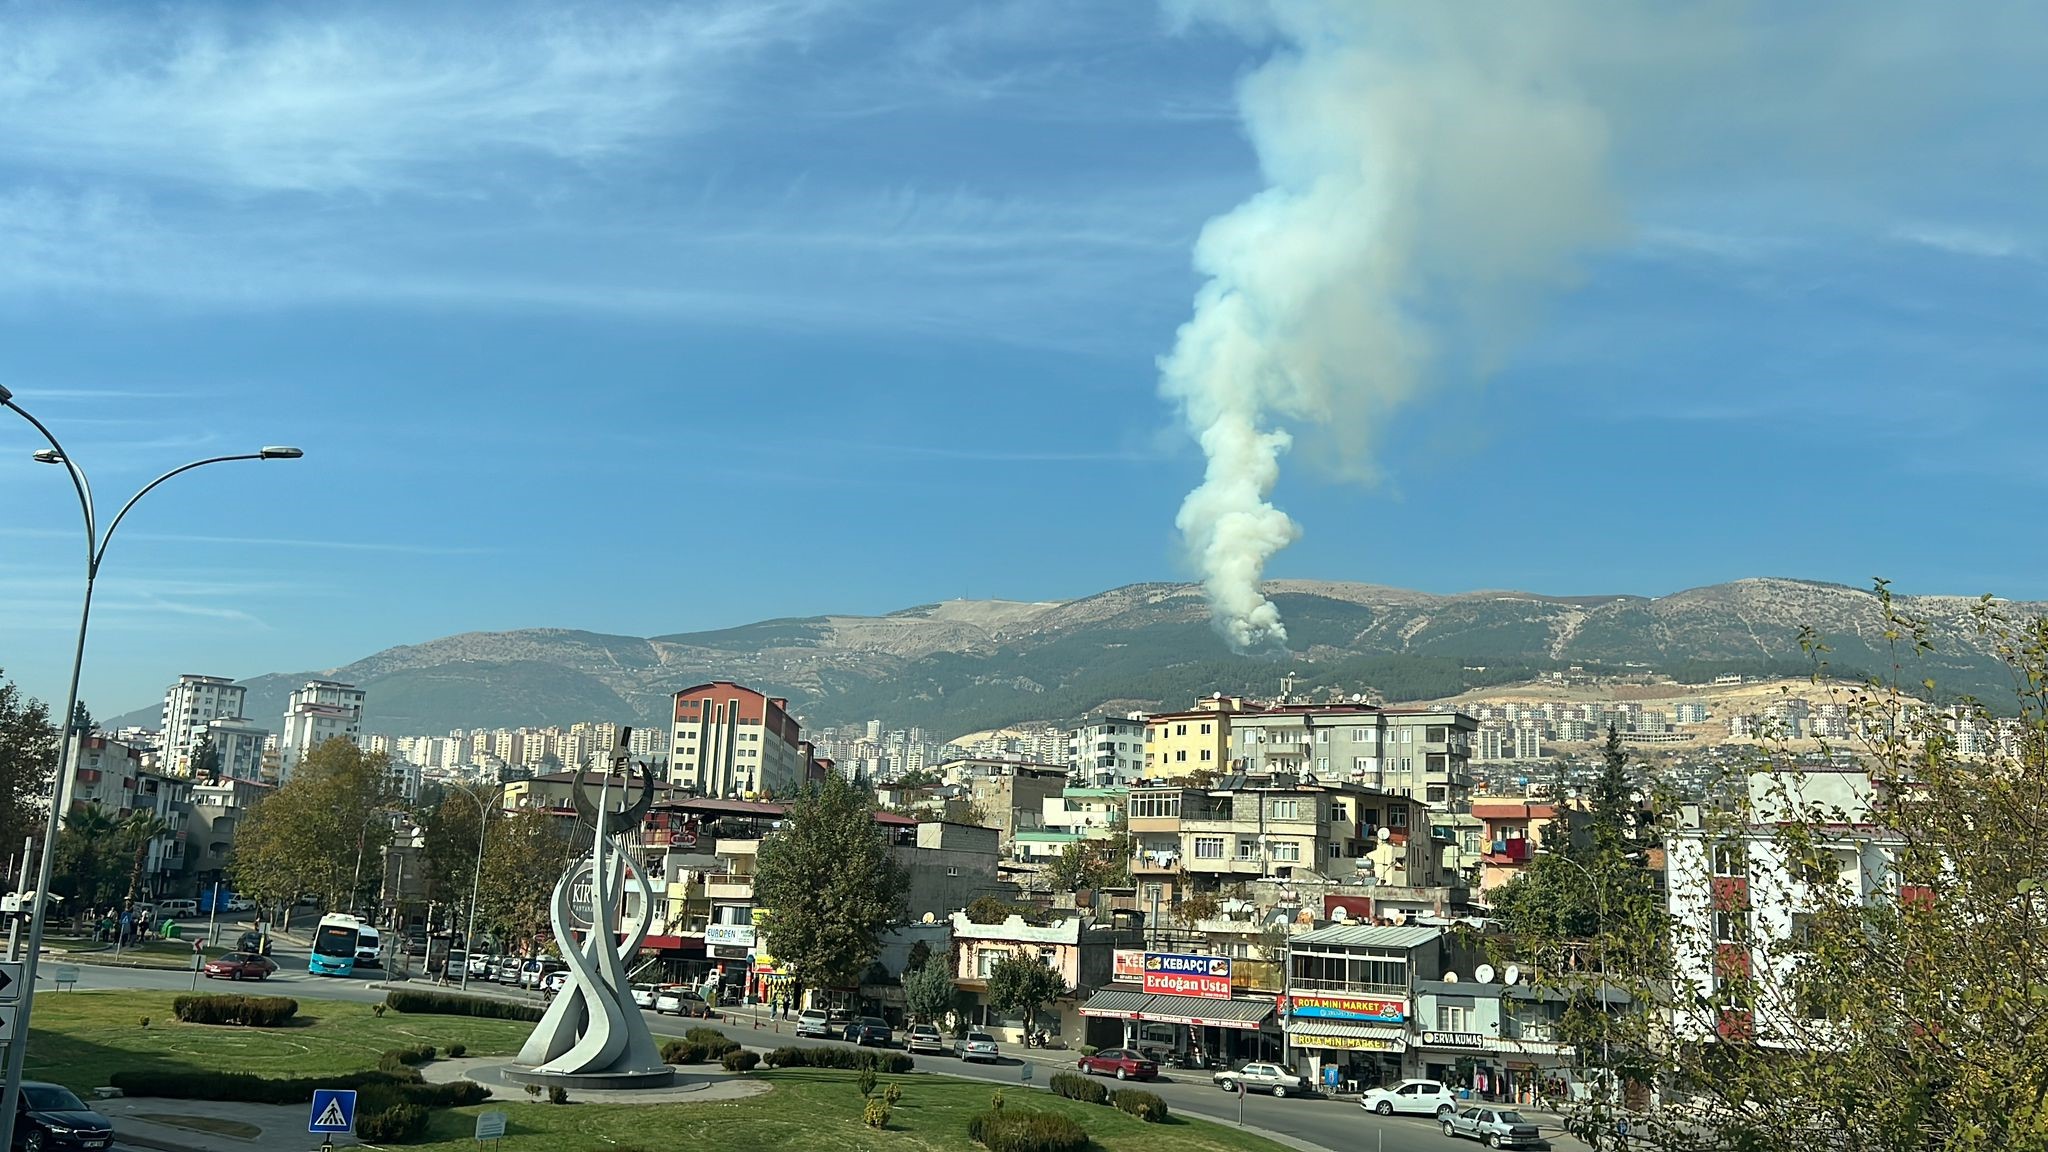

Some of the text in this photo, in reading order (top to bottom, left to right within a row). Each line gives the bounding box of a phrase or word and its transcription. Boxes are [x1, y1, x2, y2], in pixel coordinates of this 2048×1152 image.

[1125, 954, 1144, 968] KEB
[1163, 958, 1207, 973] KEBAPÇI
[1147, 975, 1228, 993] Erdoğan Usta
[1298, 999, 1320, 1008] ROTA
[1342, 1002, 1380, 1011] MARKET
[1298, 1036, 1322, 1045] ROTA
[1347, 1038, 1386, 1049] MARKET
[1433, 1033, 1482, 1049] ERVA KUMAŞ
